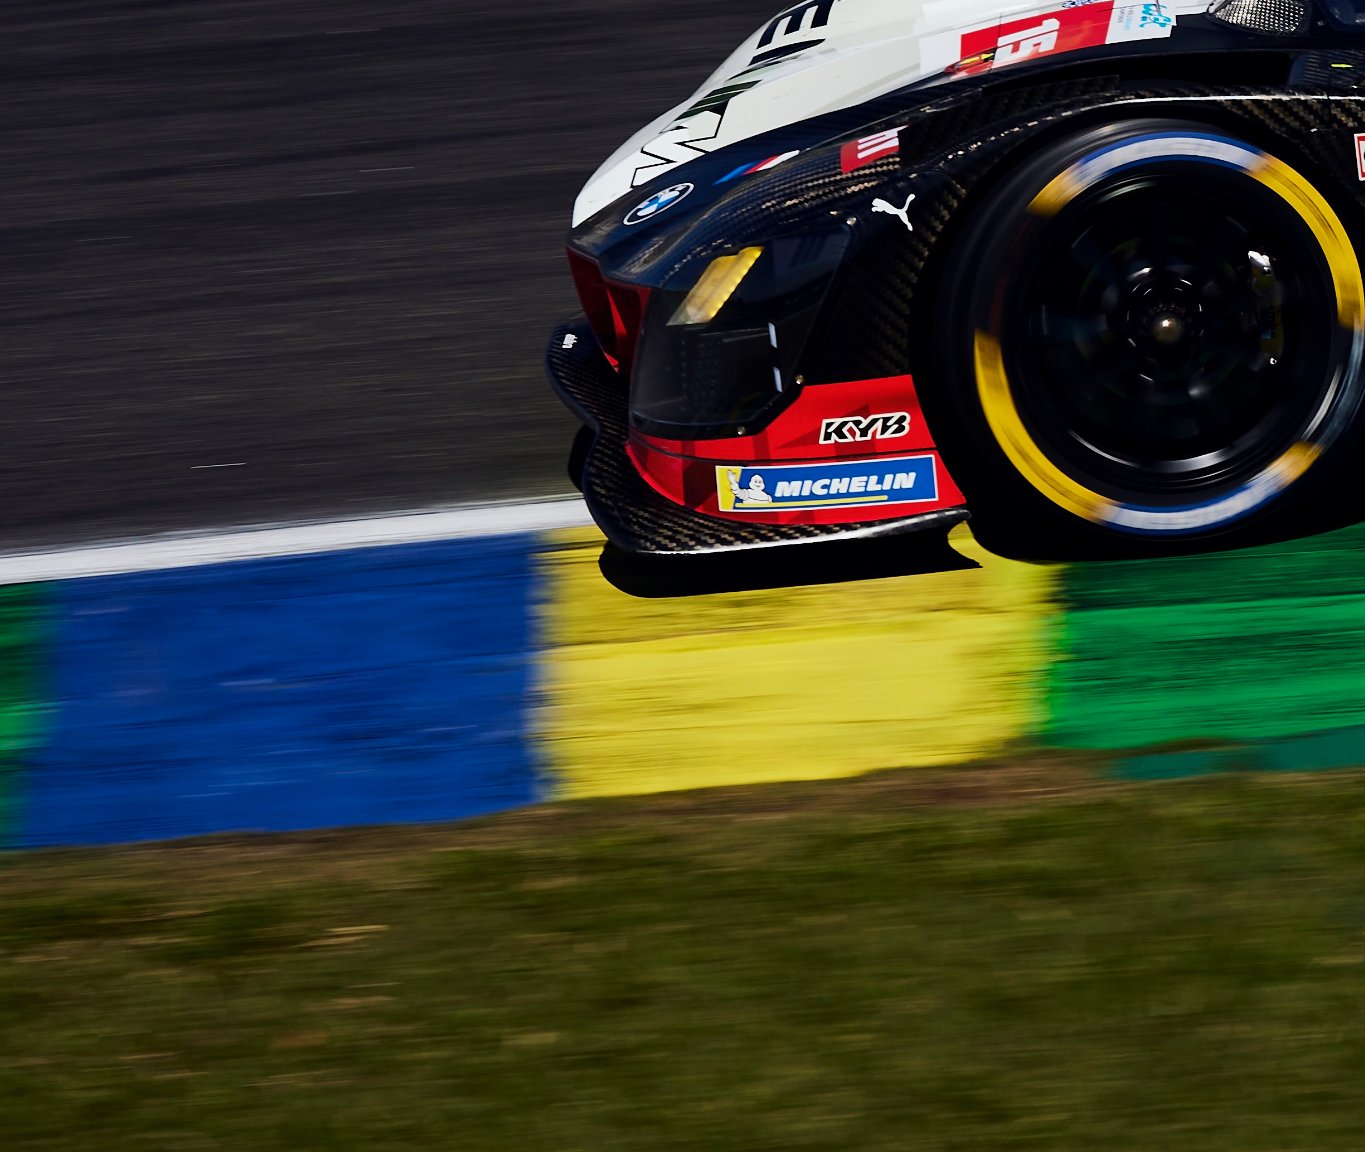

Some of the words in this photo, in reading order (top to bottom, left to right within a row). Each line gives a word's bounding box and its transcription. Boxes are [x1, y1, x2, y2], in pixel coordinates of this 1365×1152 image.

[992, 18, 1061, 69] 15
[823, 414, 908, 442] KYB
[774, 472, 917, 497] MICHELIN
